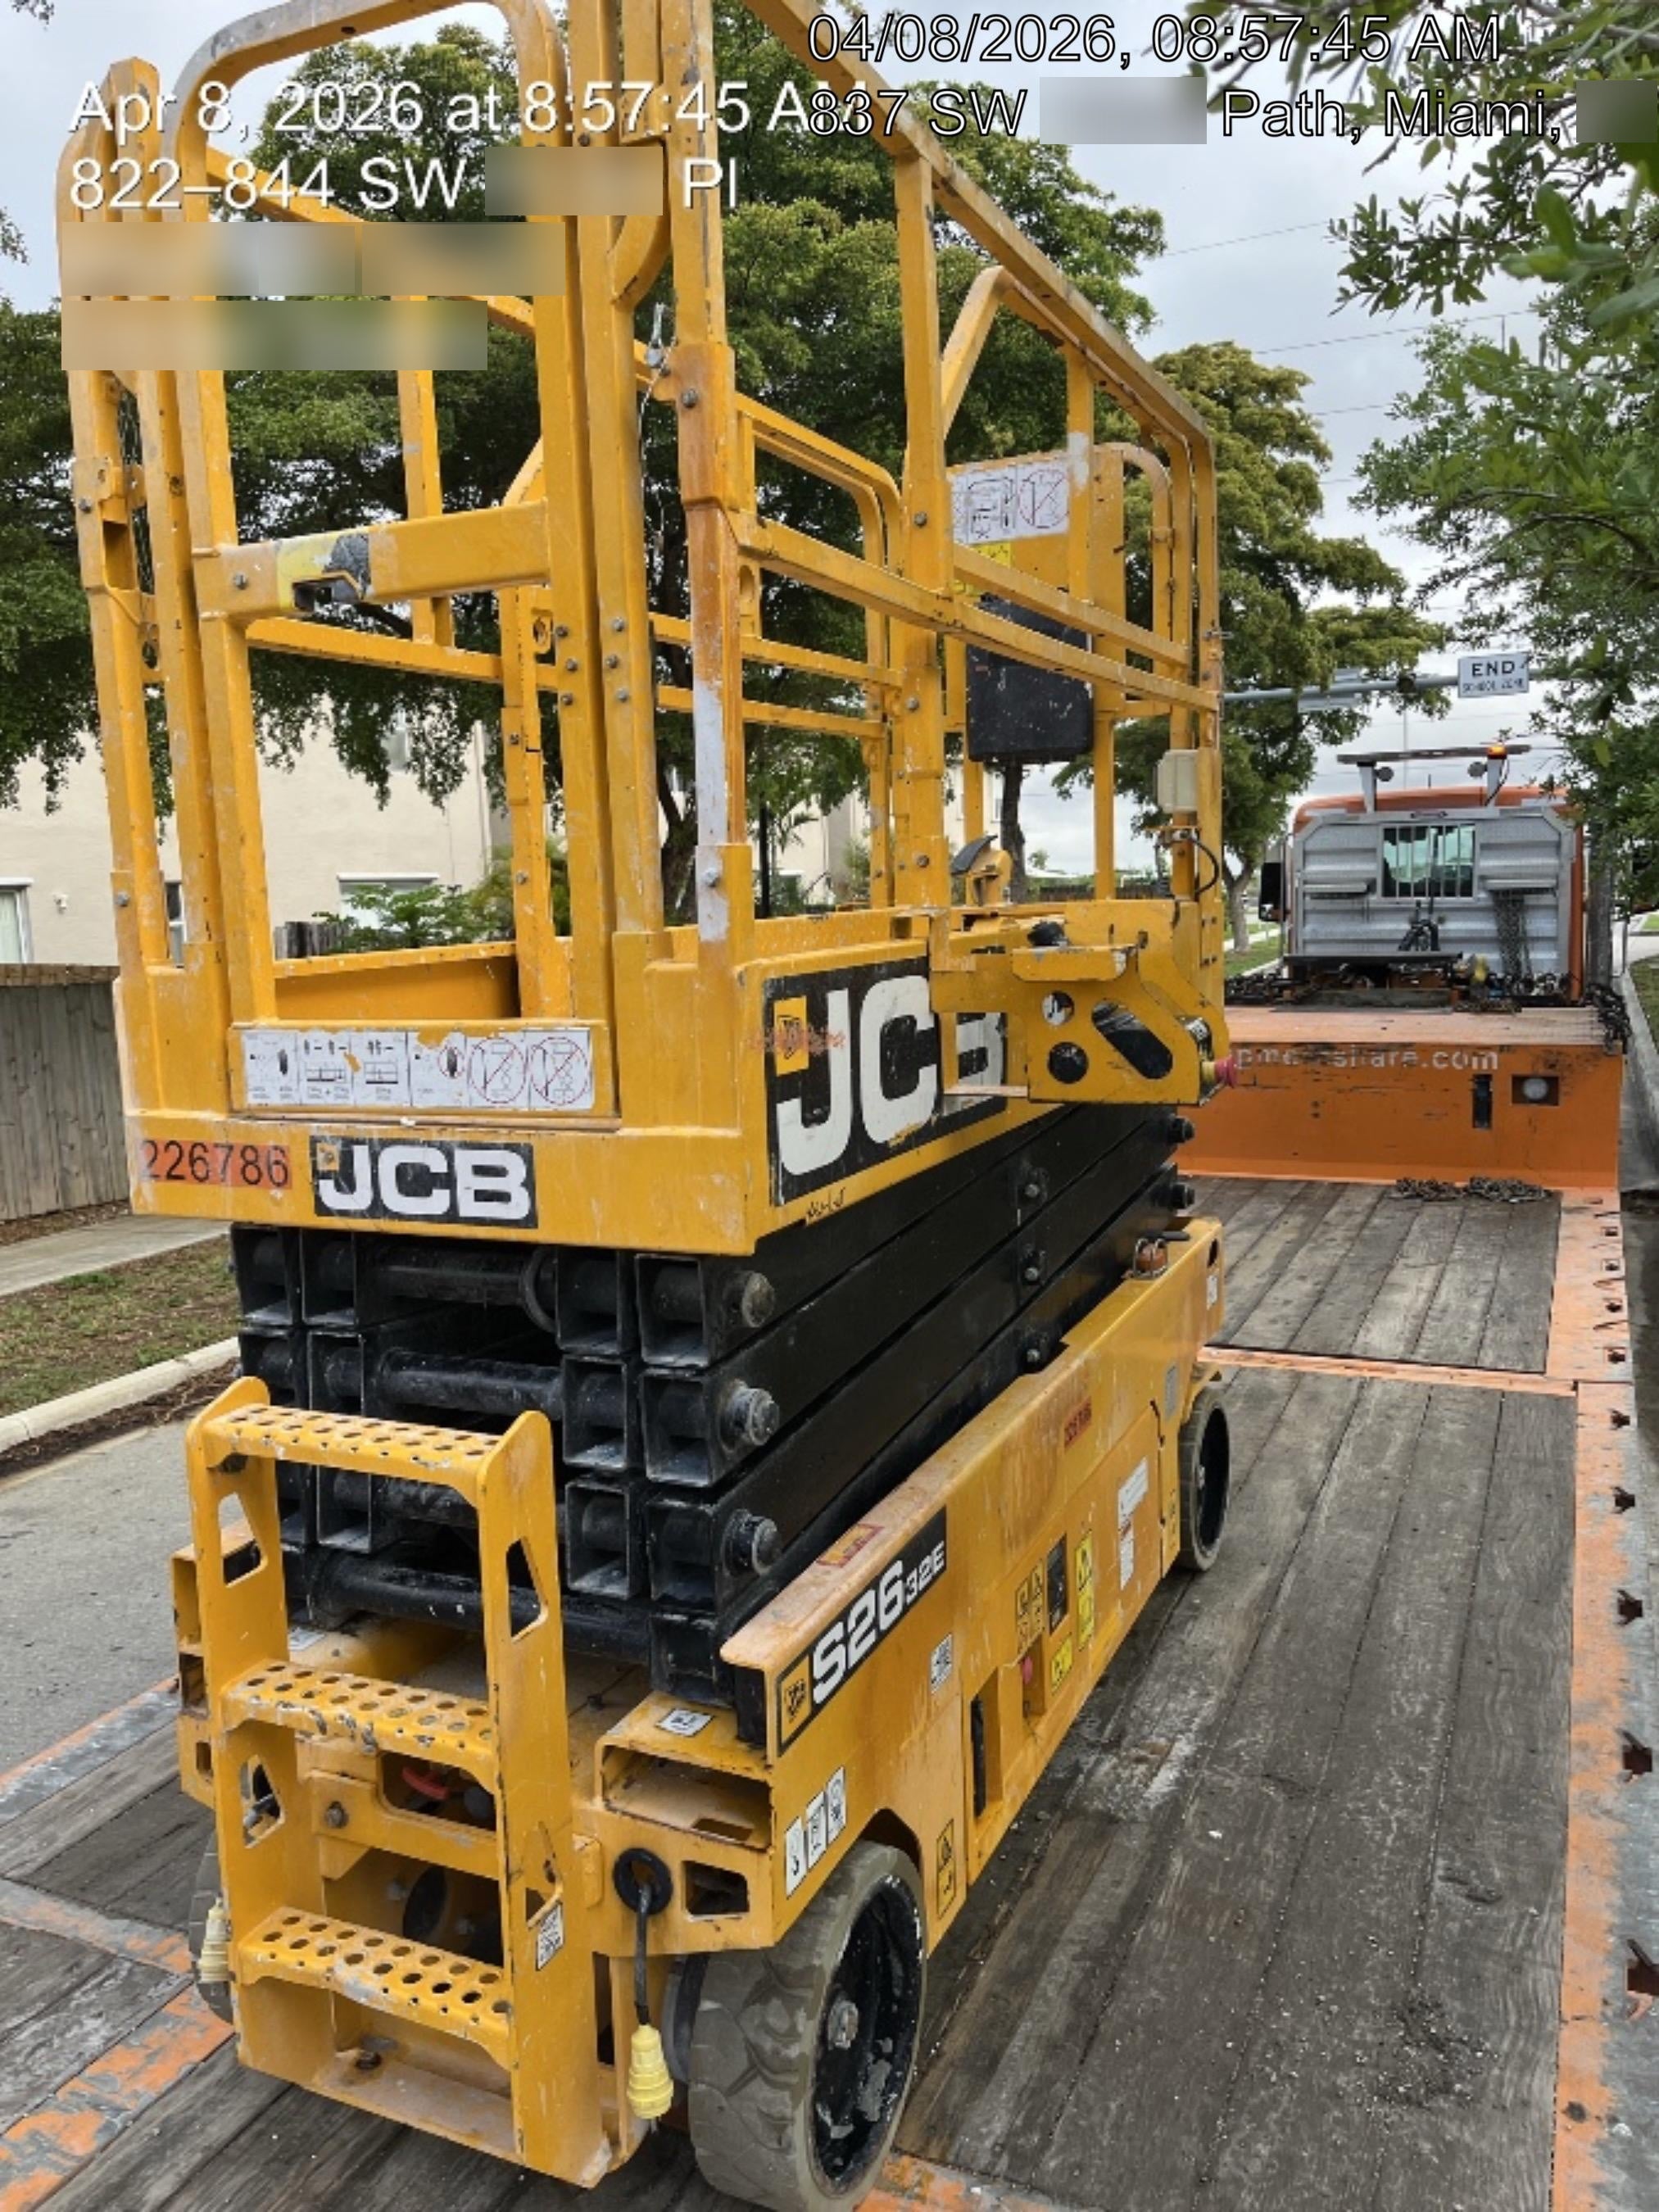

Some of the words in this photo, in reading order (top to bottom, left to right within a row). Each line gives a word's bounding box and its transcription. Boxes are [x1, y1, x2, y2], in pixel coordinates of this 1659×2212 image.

[1471, 660, 1516, 677] END
[141, 1140, 288, 1188] 226786
[318, 1145, 532, 1220] JCB
